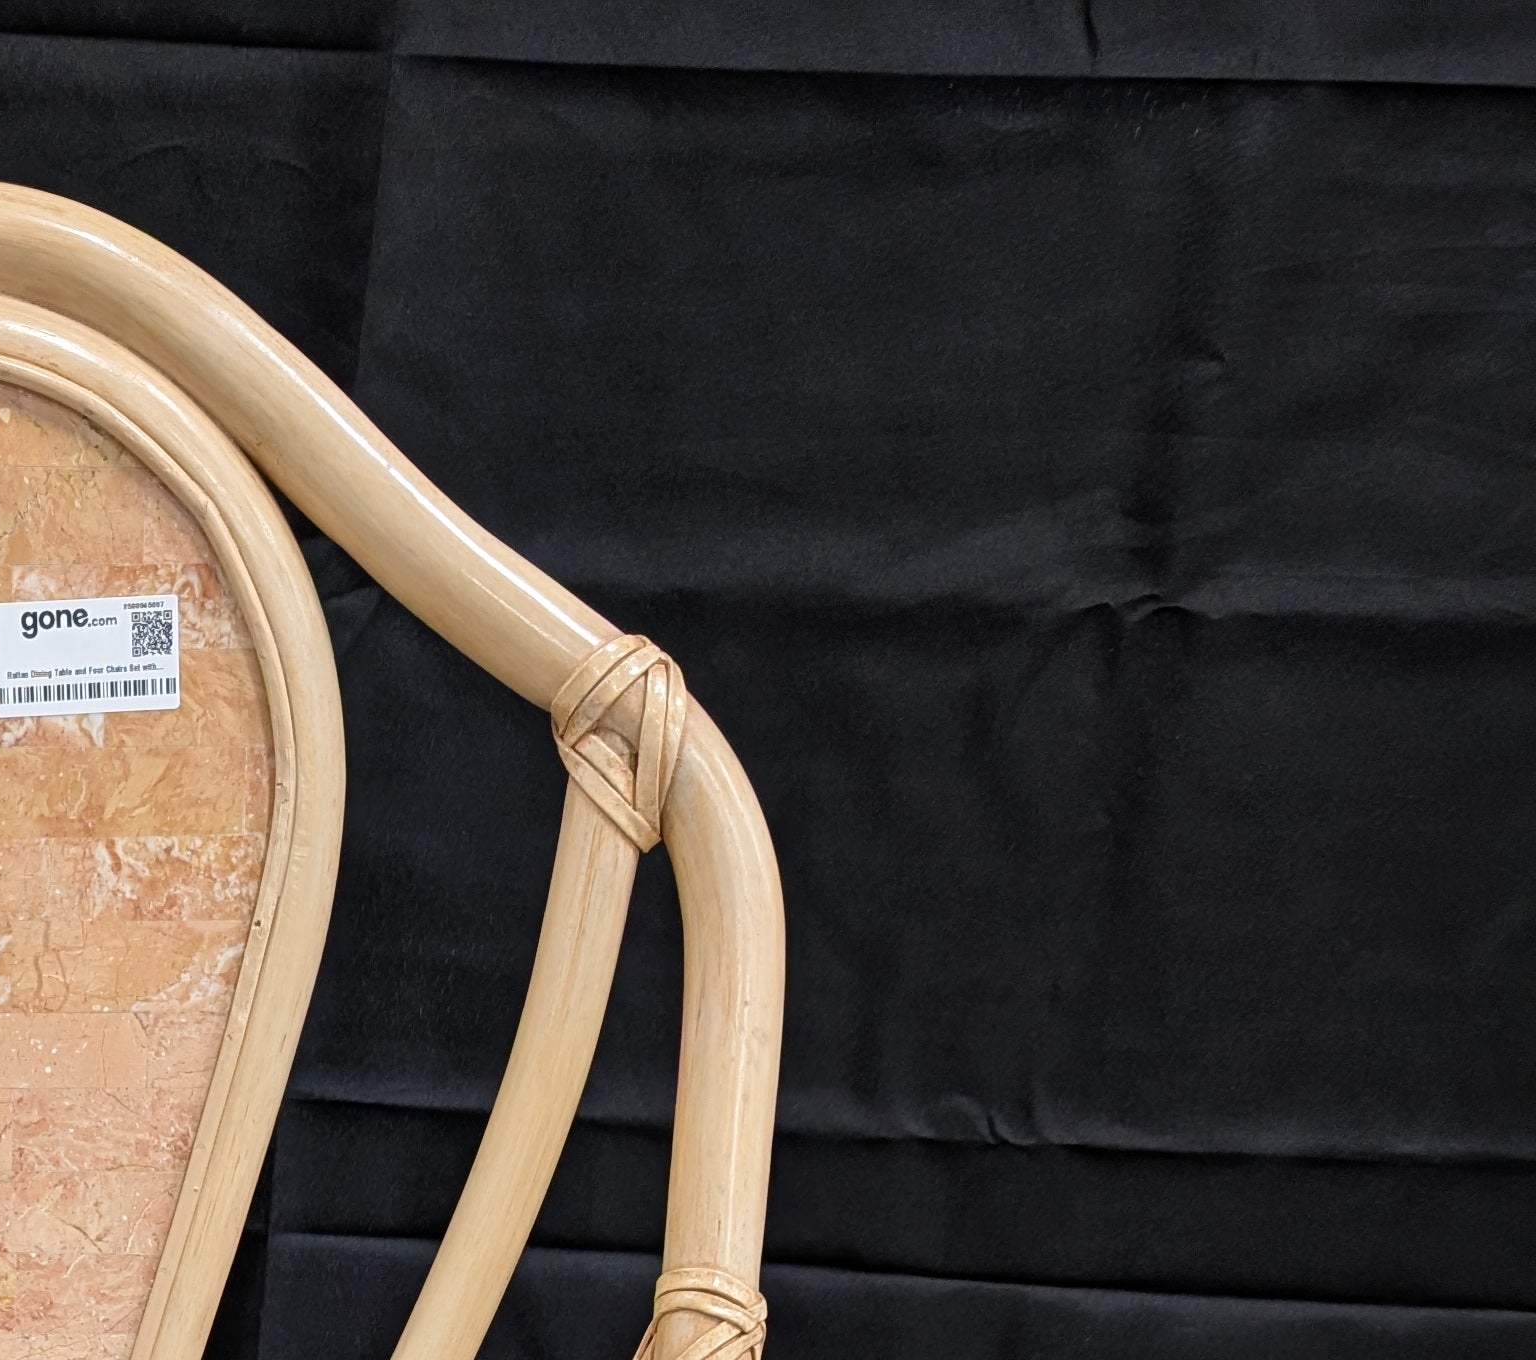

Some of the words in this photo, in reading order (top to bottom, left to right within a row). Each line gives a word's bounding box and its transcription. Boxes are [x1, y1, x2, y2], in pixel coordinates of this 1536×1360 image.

[21, 608, 118, 639] gone.com
[54, 668, 72, 677] Table
[75, 666, 86, 675] and
[89, 666, 104, 675] Four
[106, 665, 127, 673] Chairs
[129, 663, 140, 672] Set
